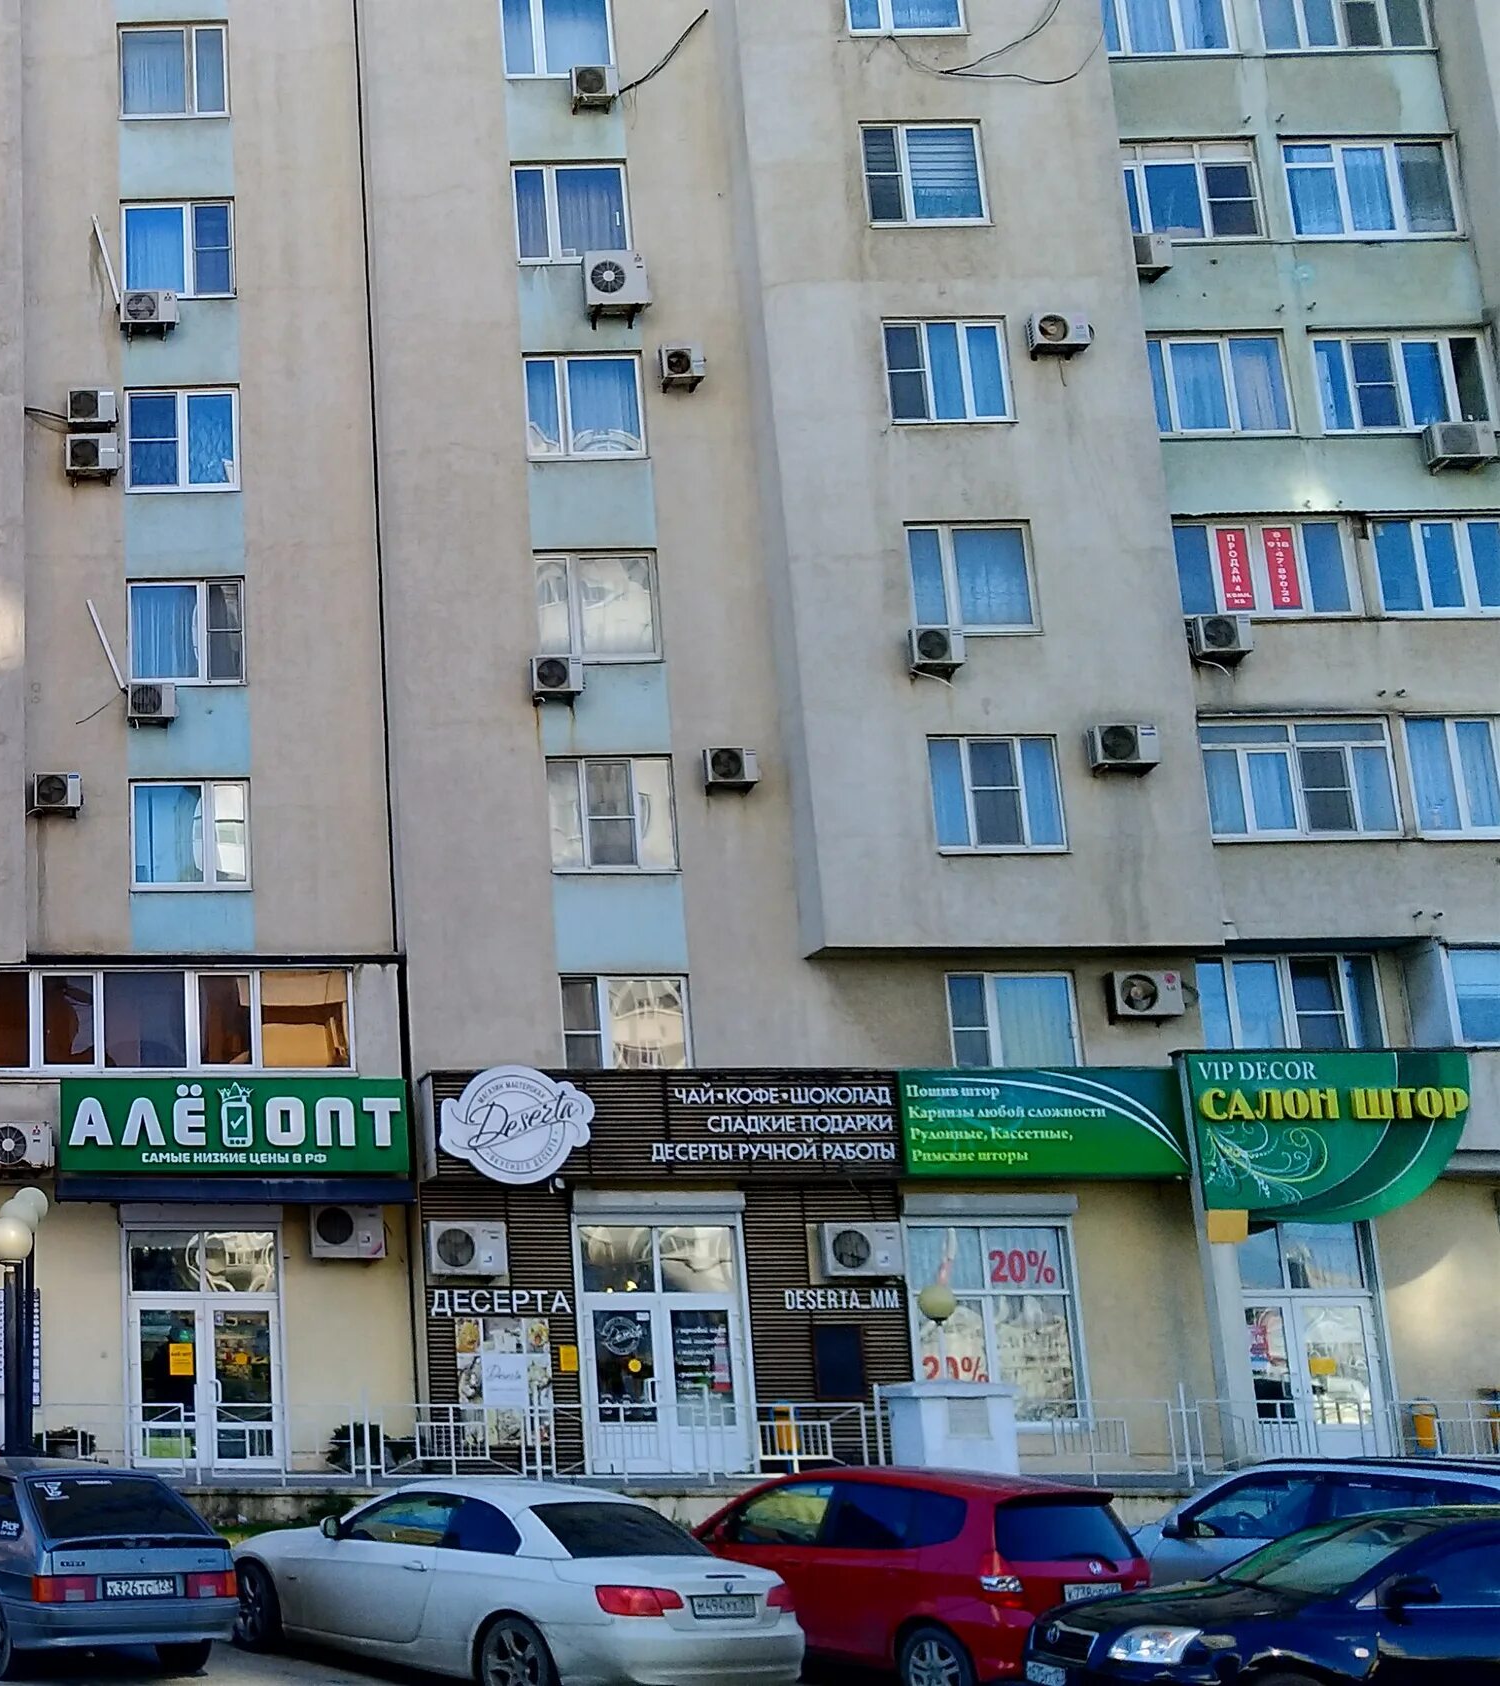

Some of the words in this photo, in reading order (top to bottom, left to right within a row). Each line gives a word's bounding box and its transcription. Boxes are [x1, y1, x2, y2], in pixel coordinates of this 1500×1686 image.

[1197, 1061, 1234, 1081] VIP
[1239, 1060, 1318, 1081] DECOR
[906, 1084, 959, 1098] Пошив
[961, 1086, 1000, 1100] штор
[908, 1105, 975, 1122] Карнизы
[978, 1105, 1025, 1119] любой
[1028, 1106, 1106, 1119] сложности
[1200, 1087, 1341, 1121] САЛОН
[1350, 1087, 1470, 1120] ШТОР
[68, 1084, 206, 1146] АЛЁ
[265, 1097, 401, 1146] ОПТ
[468, 1089, 579, 1148] Deserta
[707, 1115, 796, 1135] СЛАДКИЕ
[801, 1115, 893, 1135] ПОДАРКИ
[910, 1127, 988, 1144] Рулонные,
[991, 1127, 1074, 1142] Кассетные,
[142, 1152, 191, 1164] САМЫЕ
[193, 1153, 247, 1164] НИЗКИЕ
[250, 1152, 290, 1165] ЦЕНЫ
[292, 1153, 302, 1164] В
[305, 1152, 328, 1165] РФ
[651, 1143, 733, 1162] ДЕСЕРТЫ
[739, 1138, 817, 1160] РУЧНОЙ
[822, 1143, 896, 1160] РАБОТЫ
[912, 1149, 975, 1163] Римские
[978, 1150, 1030, 1164] шторы
[988, 1249, 1056, 1284] 20%
[431, 1289, 573, 1317] ДЕСЕРТА
[784, 1289, 899, 1311] DESERTA_MM
